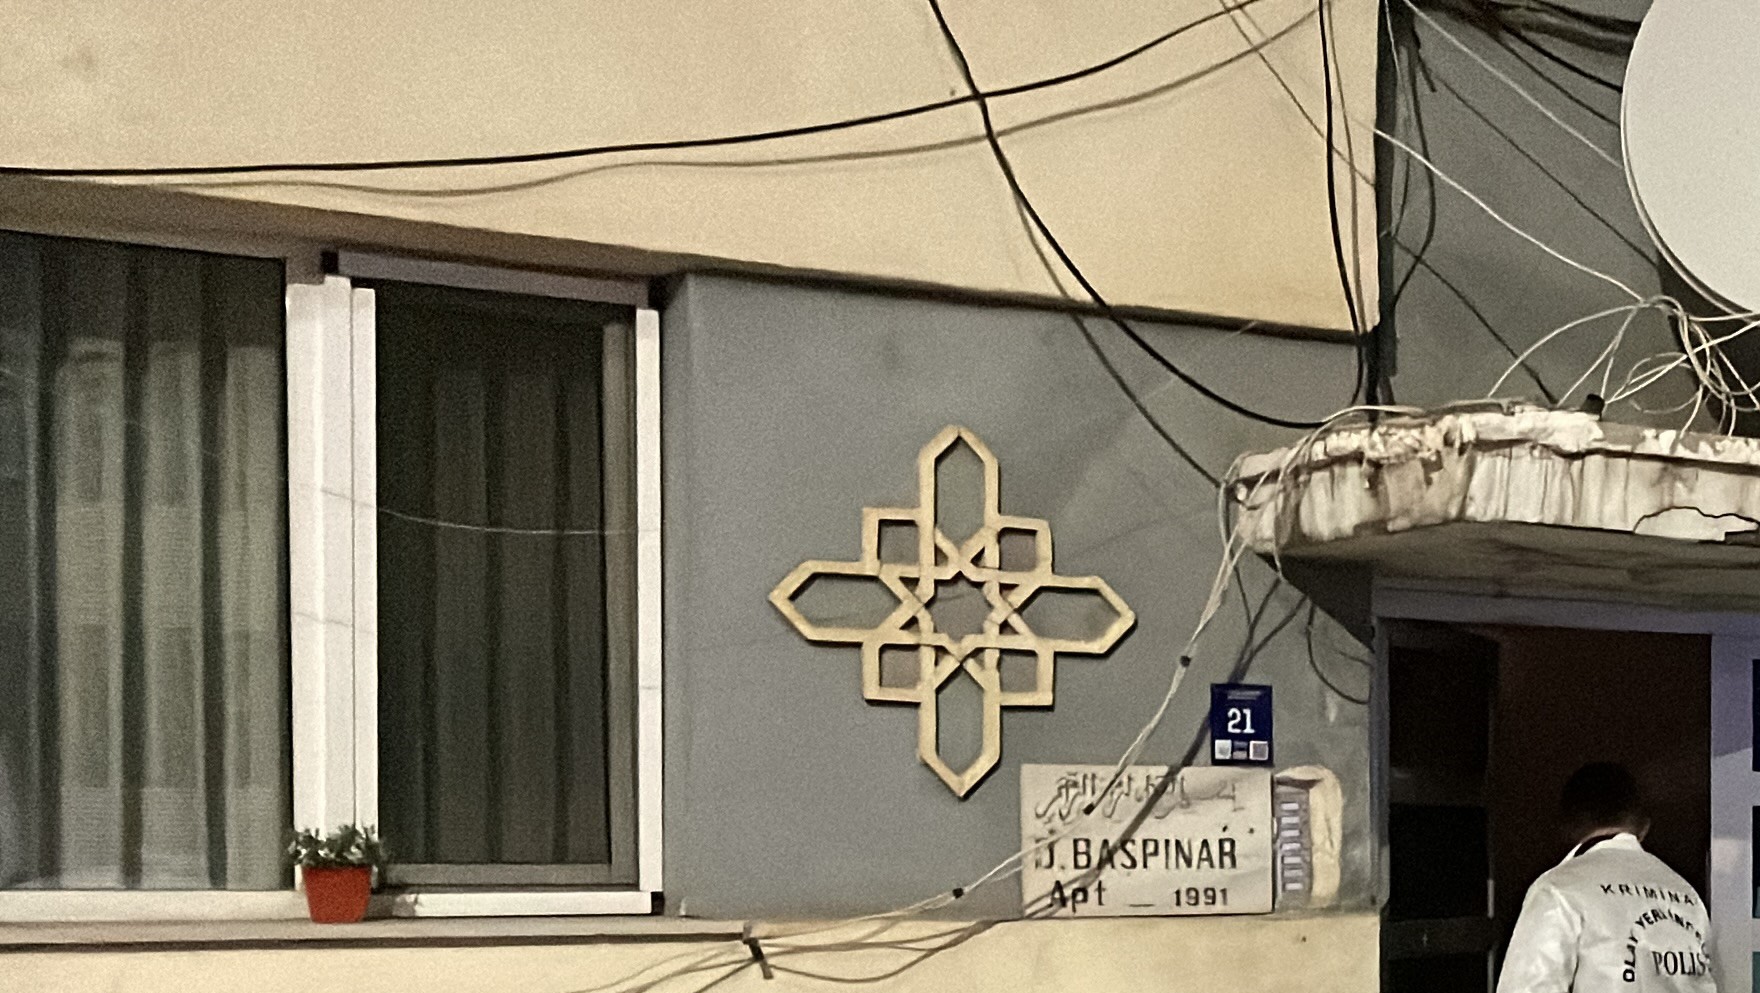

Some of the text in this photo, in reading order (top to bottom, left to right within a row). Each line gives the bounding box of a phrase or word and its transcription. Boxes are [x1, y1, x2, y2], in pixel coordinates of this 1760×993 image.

[1227, 707, 1256, 734] 21
[1050, 880, 1106, 914] Apt
[1174, 887, 1229, 907] 1991
